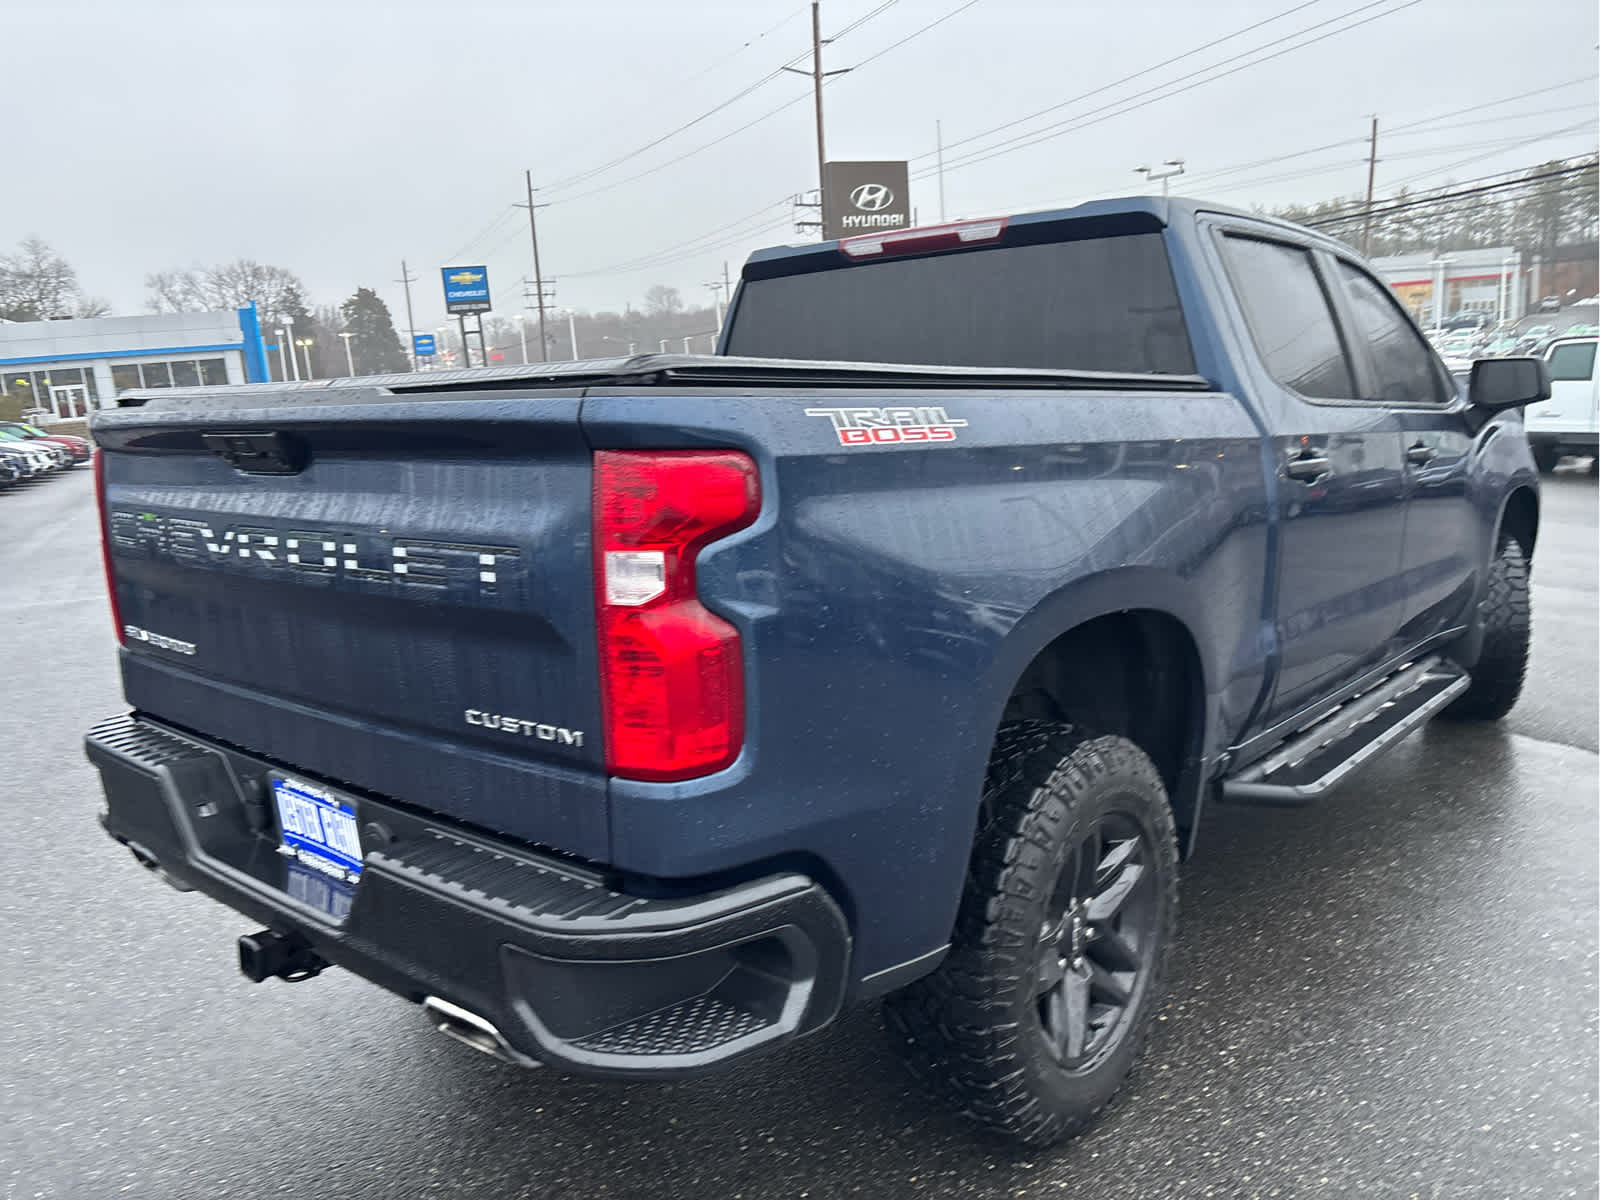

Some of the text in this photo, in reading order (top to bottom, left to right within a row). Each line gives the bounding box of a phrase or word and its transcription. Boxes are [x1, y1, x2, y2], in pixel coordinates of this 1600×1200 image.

[842, 213, 904, 228] HYUNDAI
[804, 407, 969, 428] TRAIL
[839, 426, 956, 446] BOSS
[111, 511, 521, 595] CHEVROLET
[464, 709, 584, 747] CUSTOM
